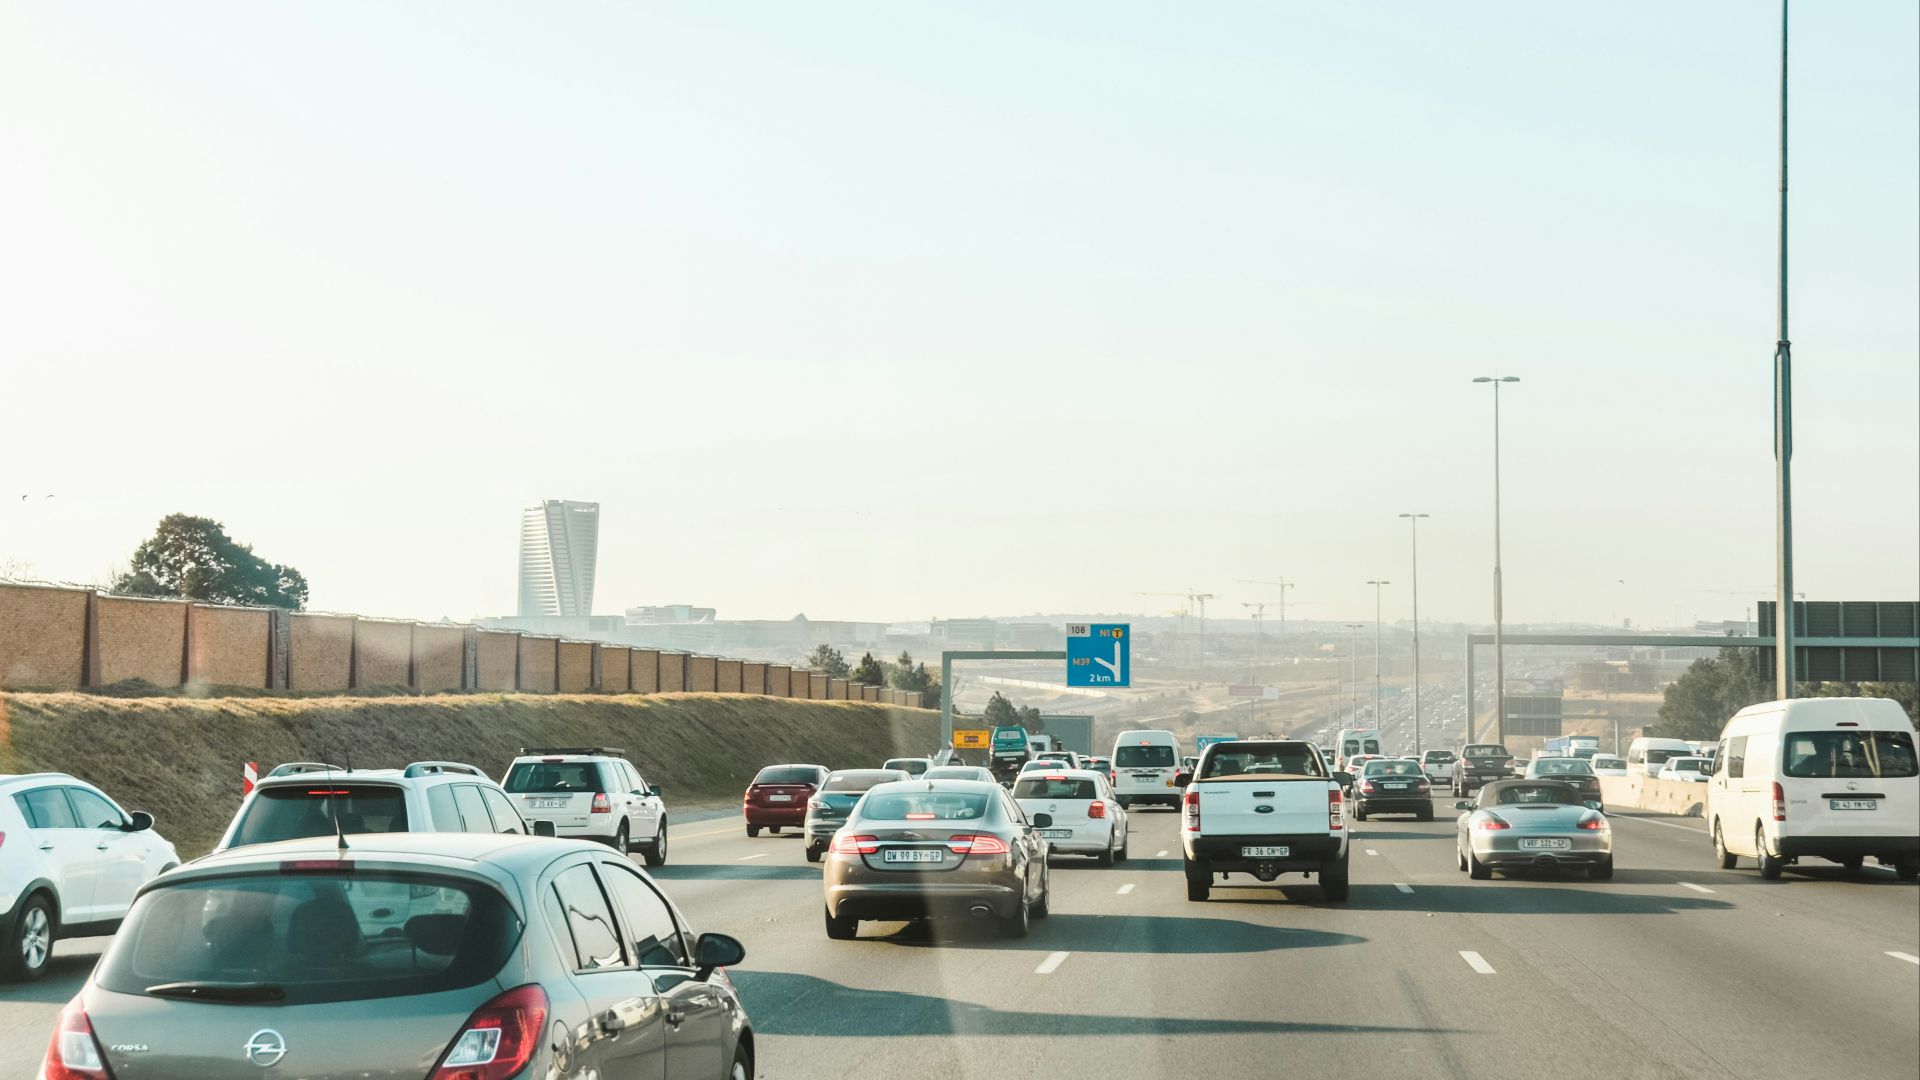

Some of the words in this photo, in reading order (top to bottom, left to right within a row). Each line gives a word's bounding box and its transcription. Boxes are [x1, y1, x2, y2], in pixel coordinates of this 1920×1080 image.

[1072, 626, 1086, 634] 108
[1100, 629, 1110, 637] N1
[1072, 657, 1091, 666] M39
[1090, 674, 1096, 682] 2
[1096, 674, 1111, 682] km
[900, 851, 910, 860] 99
[913, 851, 923, 860] BY
[929, 851, 940, 860] GP
[1242, 847, 1252, 856] FR
[1256, 847, 1264, 856] 36
[1279, 847, 1288, 856] GP
